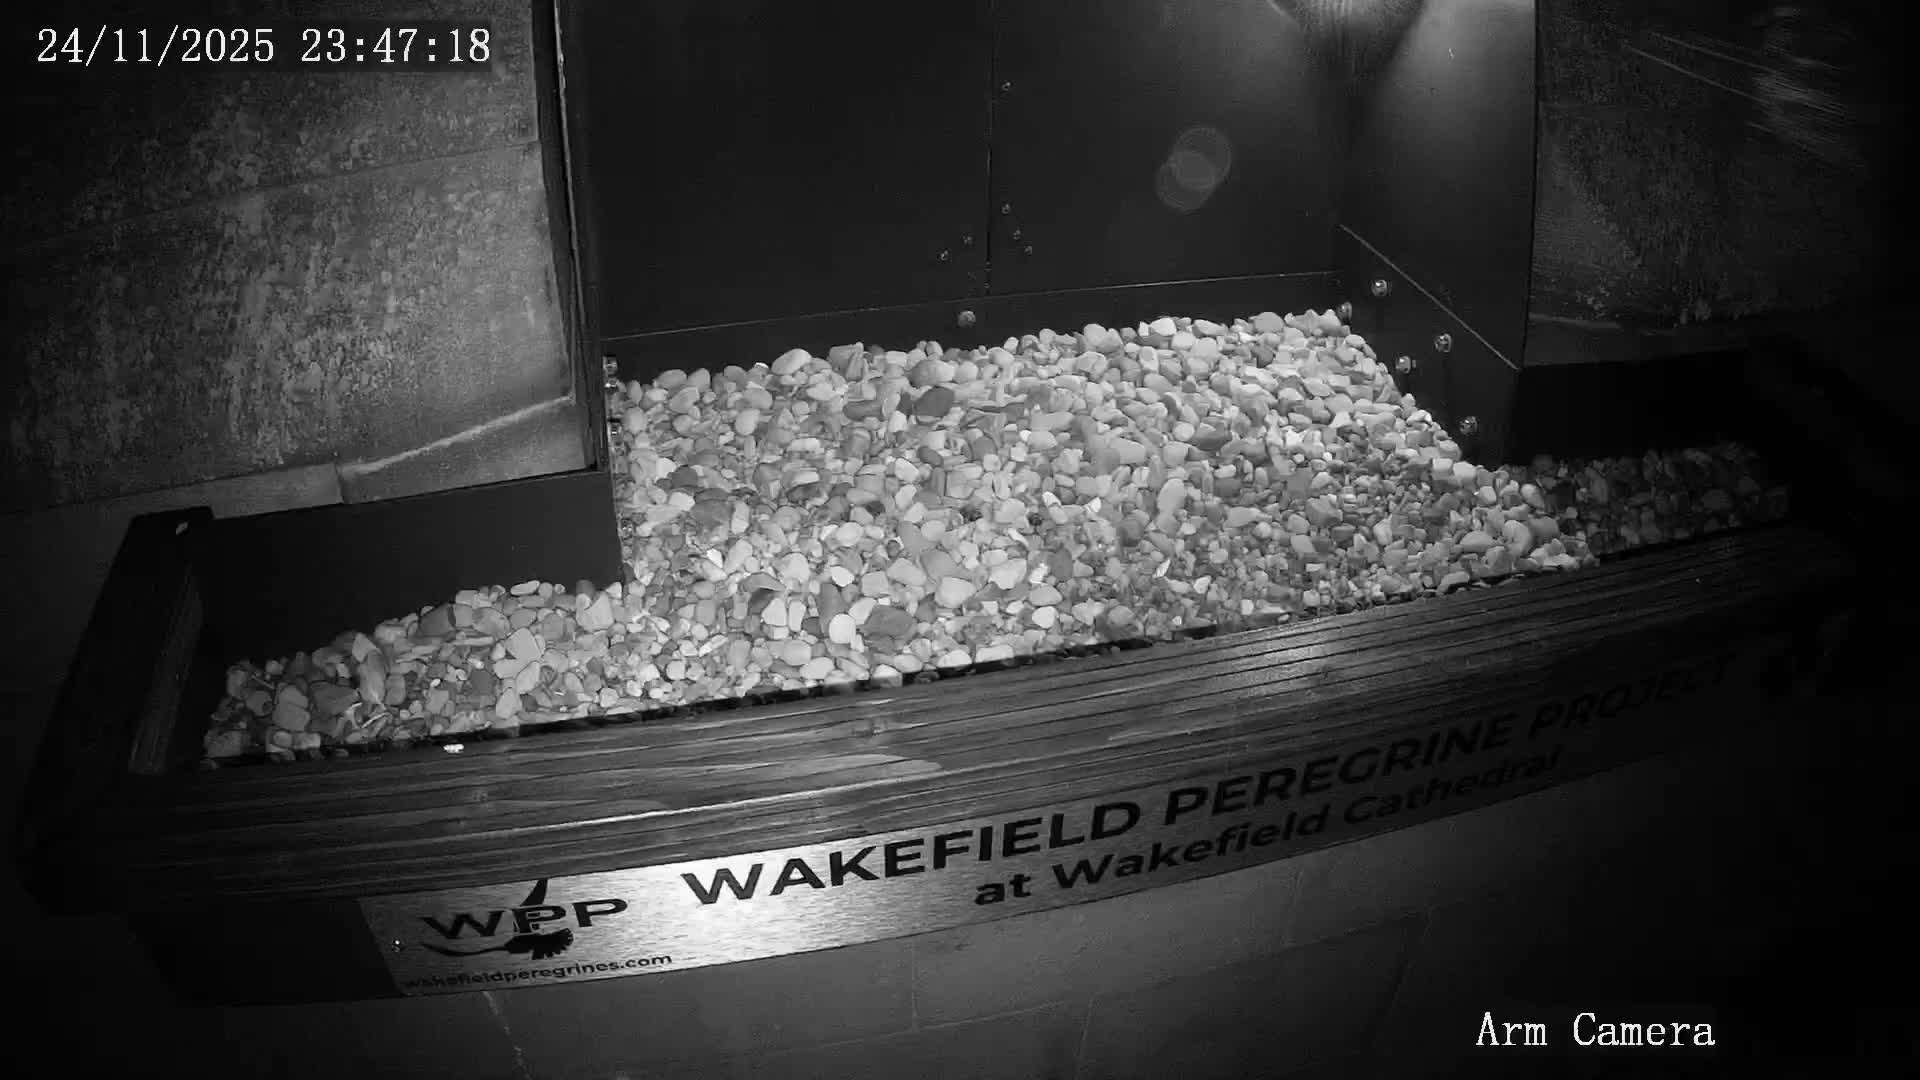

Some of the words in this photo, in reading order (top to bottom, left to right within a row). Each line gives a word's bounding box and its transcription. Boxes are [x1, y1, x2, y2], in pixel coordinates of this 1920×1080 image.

[681, 800, 1141, 905] WAKEFIELD
[1164, 711, 1517, 827] PEREGRINE
[1528, 653, 1738, 740] PROJECT
[975, 873, 1031, 905] at
[1052, 802, 1332, 889] Wakefield
[1344, 743, 1562, 824] Cathedral
[419, 898, 628, 939] WPP
[403, 953, 673, 988] wakefieldperegrines.com
